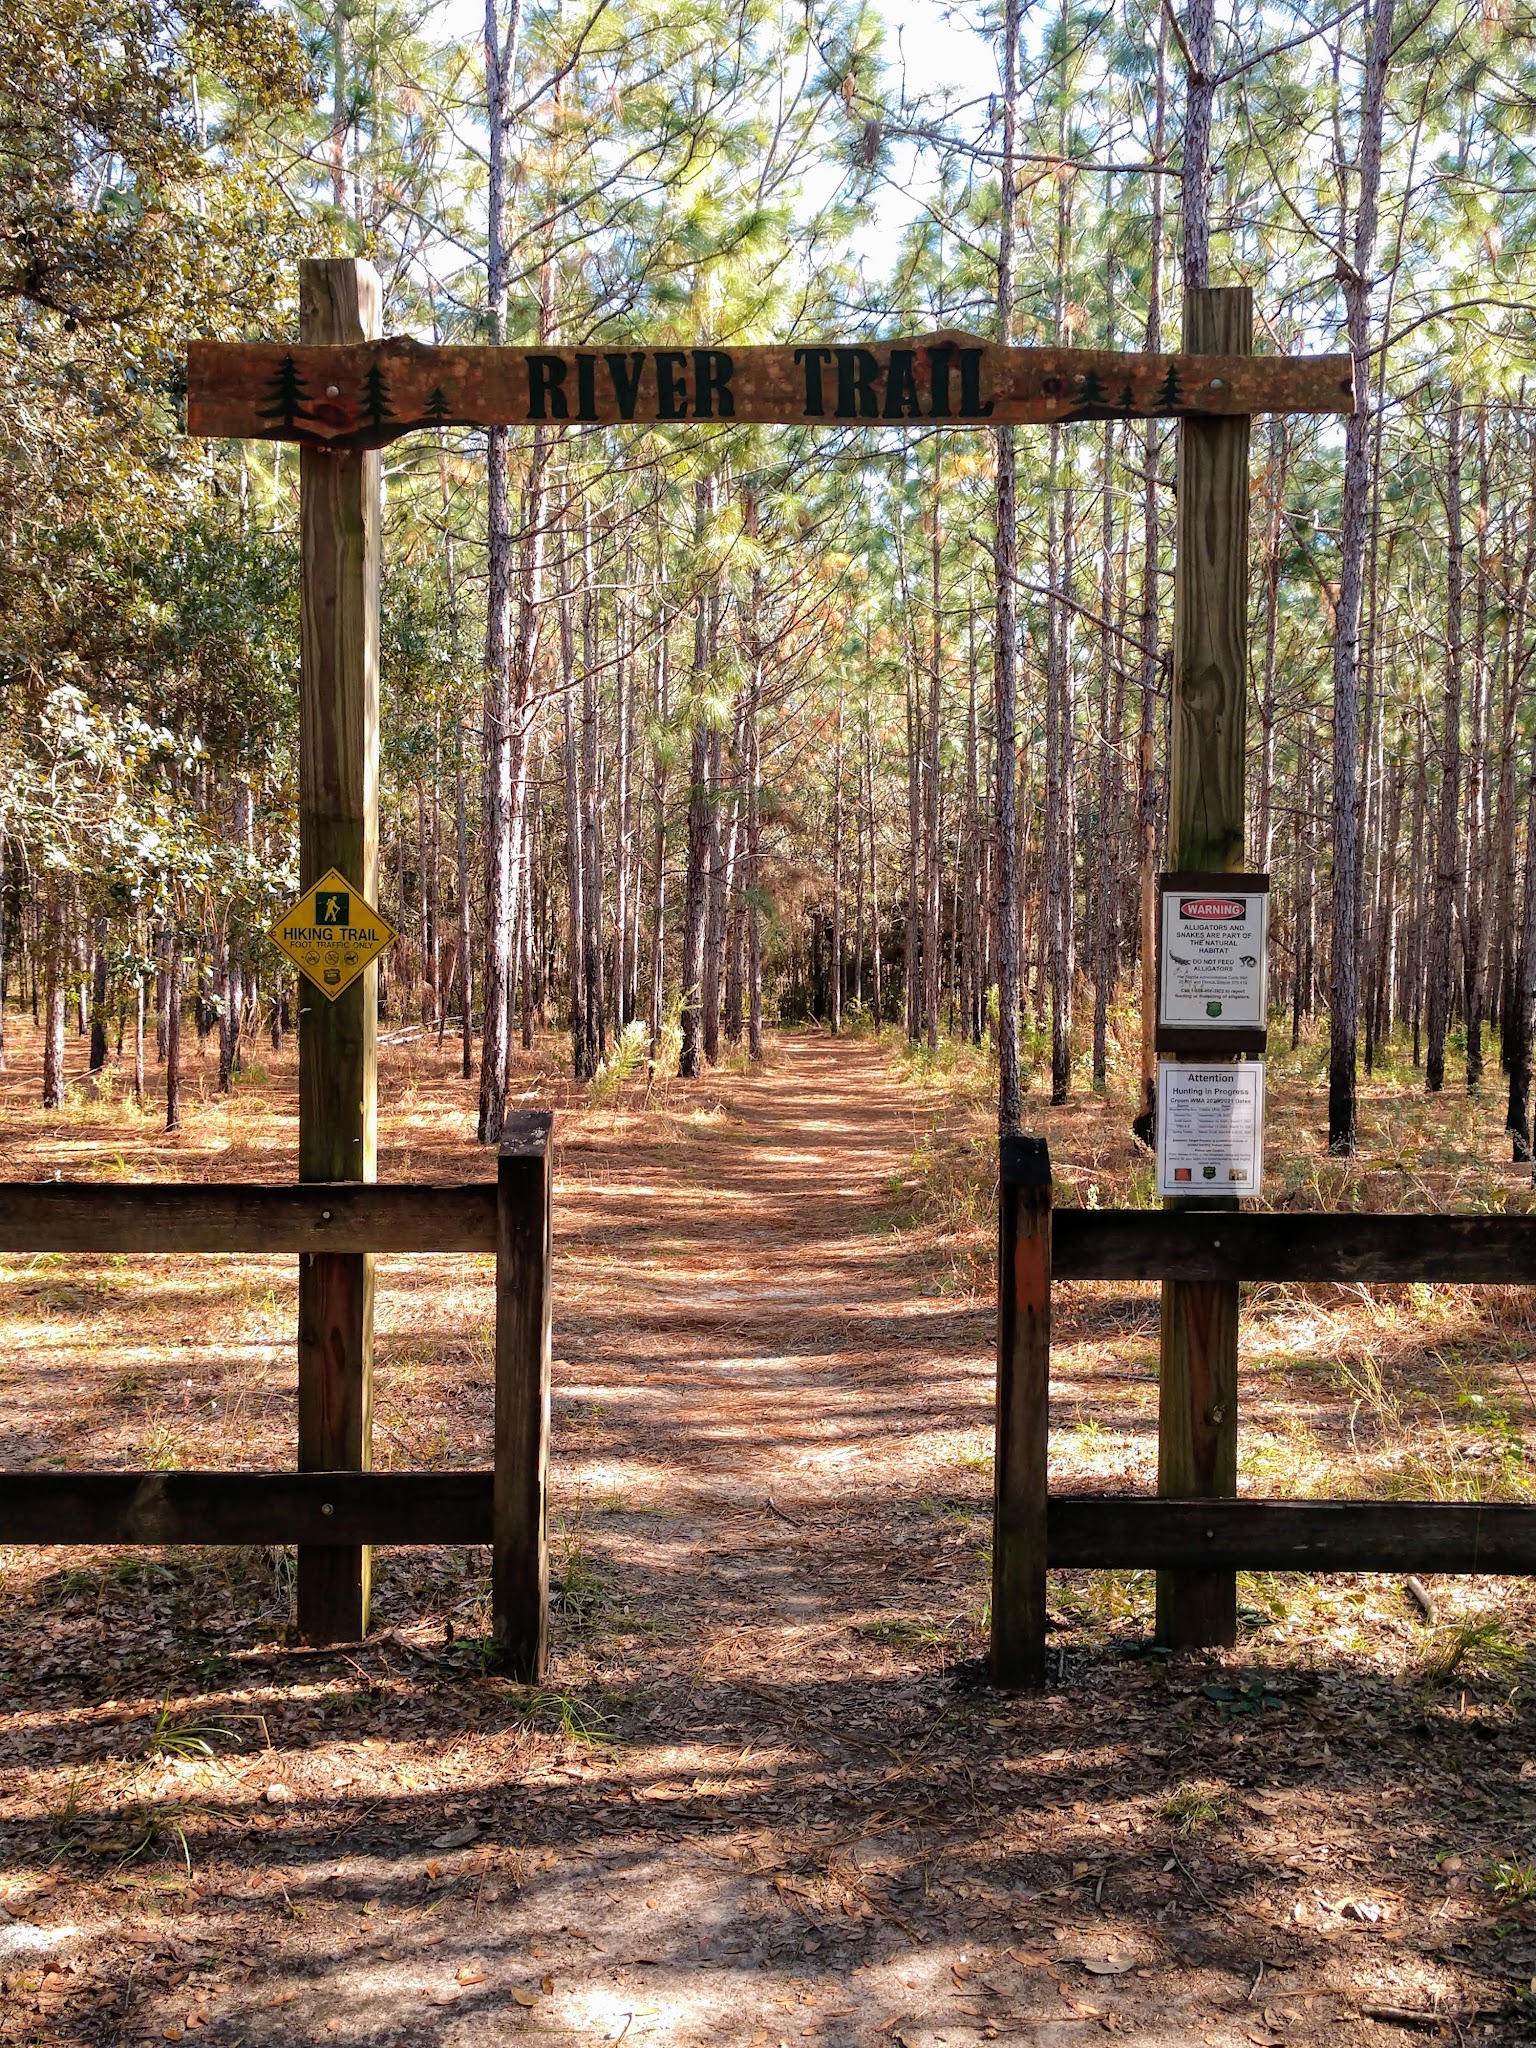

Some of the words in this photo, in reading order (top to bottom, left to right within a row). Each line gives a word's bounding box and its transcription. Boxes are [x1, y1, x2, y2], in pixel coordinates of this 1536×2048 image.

[525, 349, 736, 421] RIVER
[794, 347, 994, 419] TRAIL
[1187, 904, 1240, 915] WARNING
[283, 927, 333, 940] HIKING
[339, 928, 380, 941] TRAIL
[1188, 1073, 1234, 1082] Attention
[1172, 1088, 1203, 1096] Hunting
[1214, 1088, 1249, 1096] Progress
